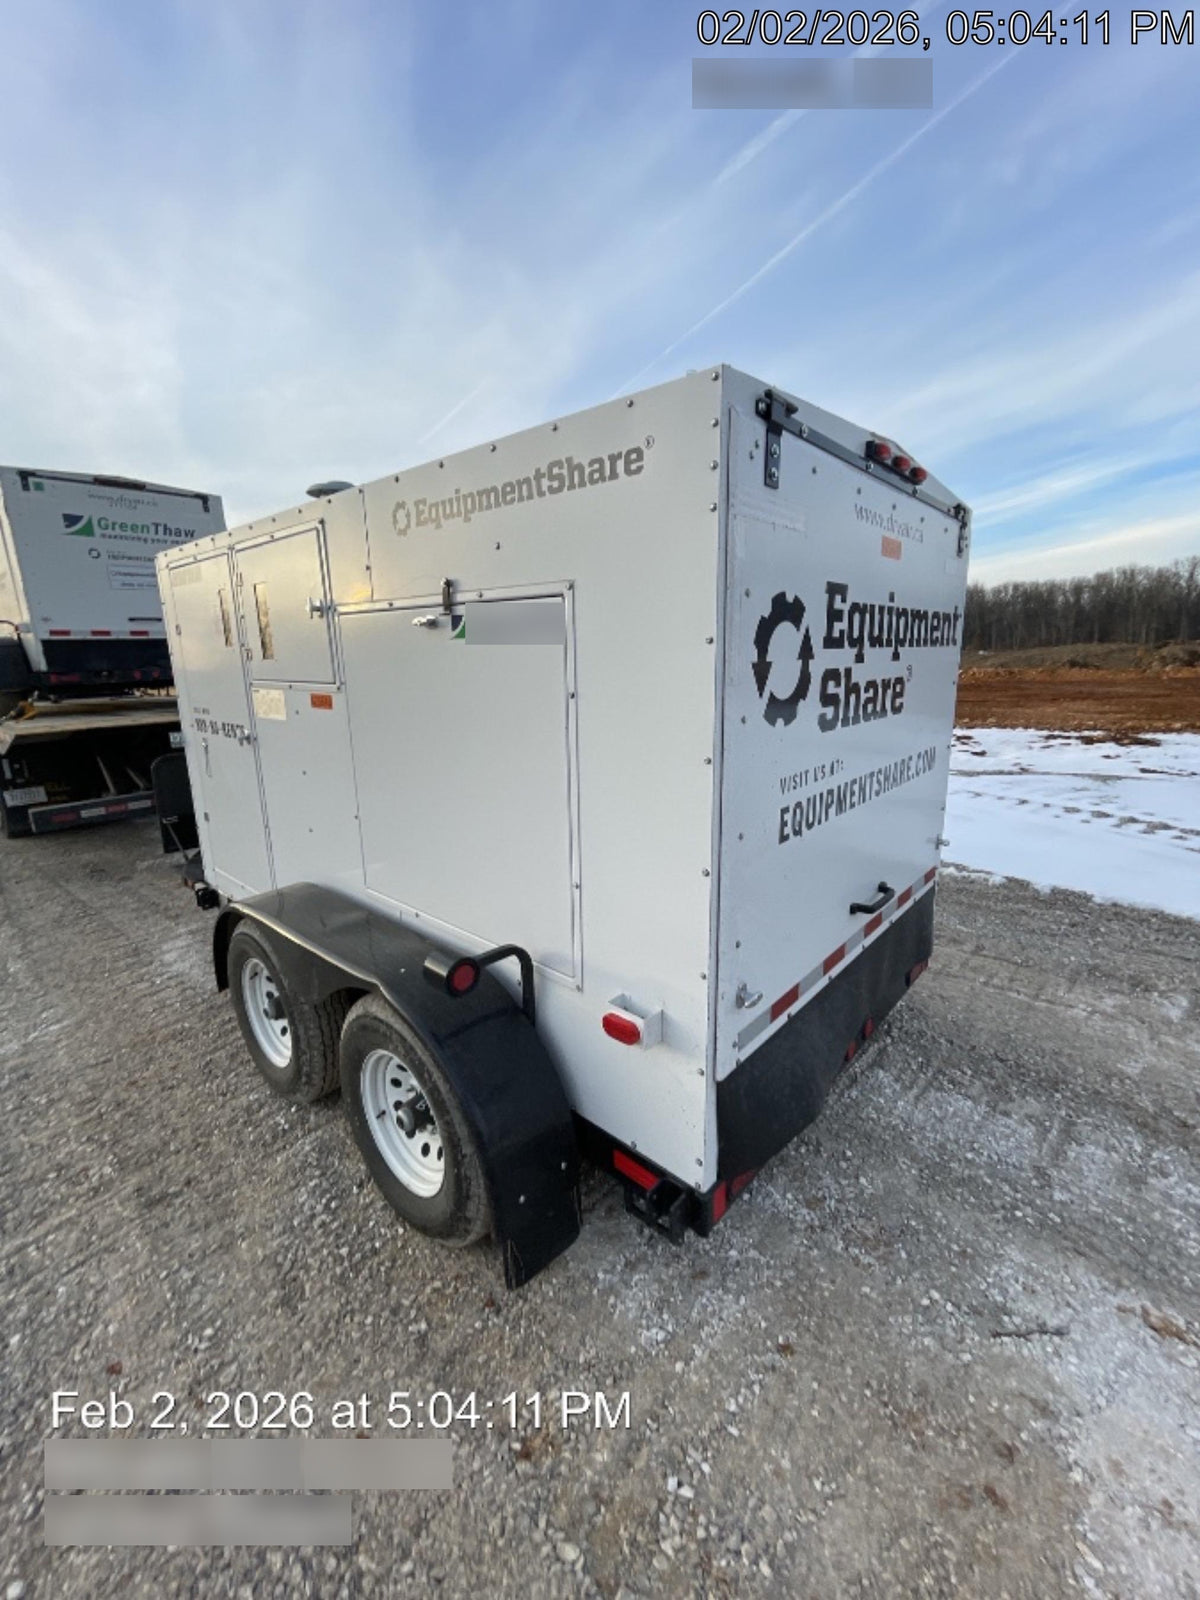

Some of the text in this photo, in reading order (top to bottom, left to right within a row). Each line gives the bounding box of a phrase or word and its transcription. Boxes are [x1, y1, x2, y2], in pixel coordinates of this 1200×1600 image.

[97, 517, 196, 538] GreenThaw
[822, 581, 962, 663] Equipment
[817, 666, 904, 733] Share
[778, 747, 937, 845] EQUIPMENTSHARE.COM
[780, 769, 810, 795] VISIT
